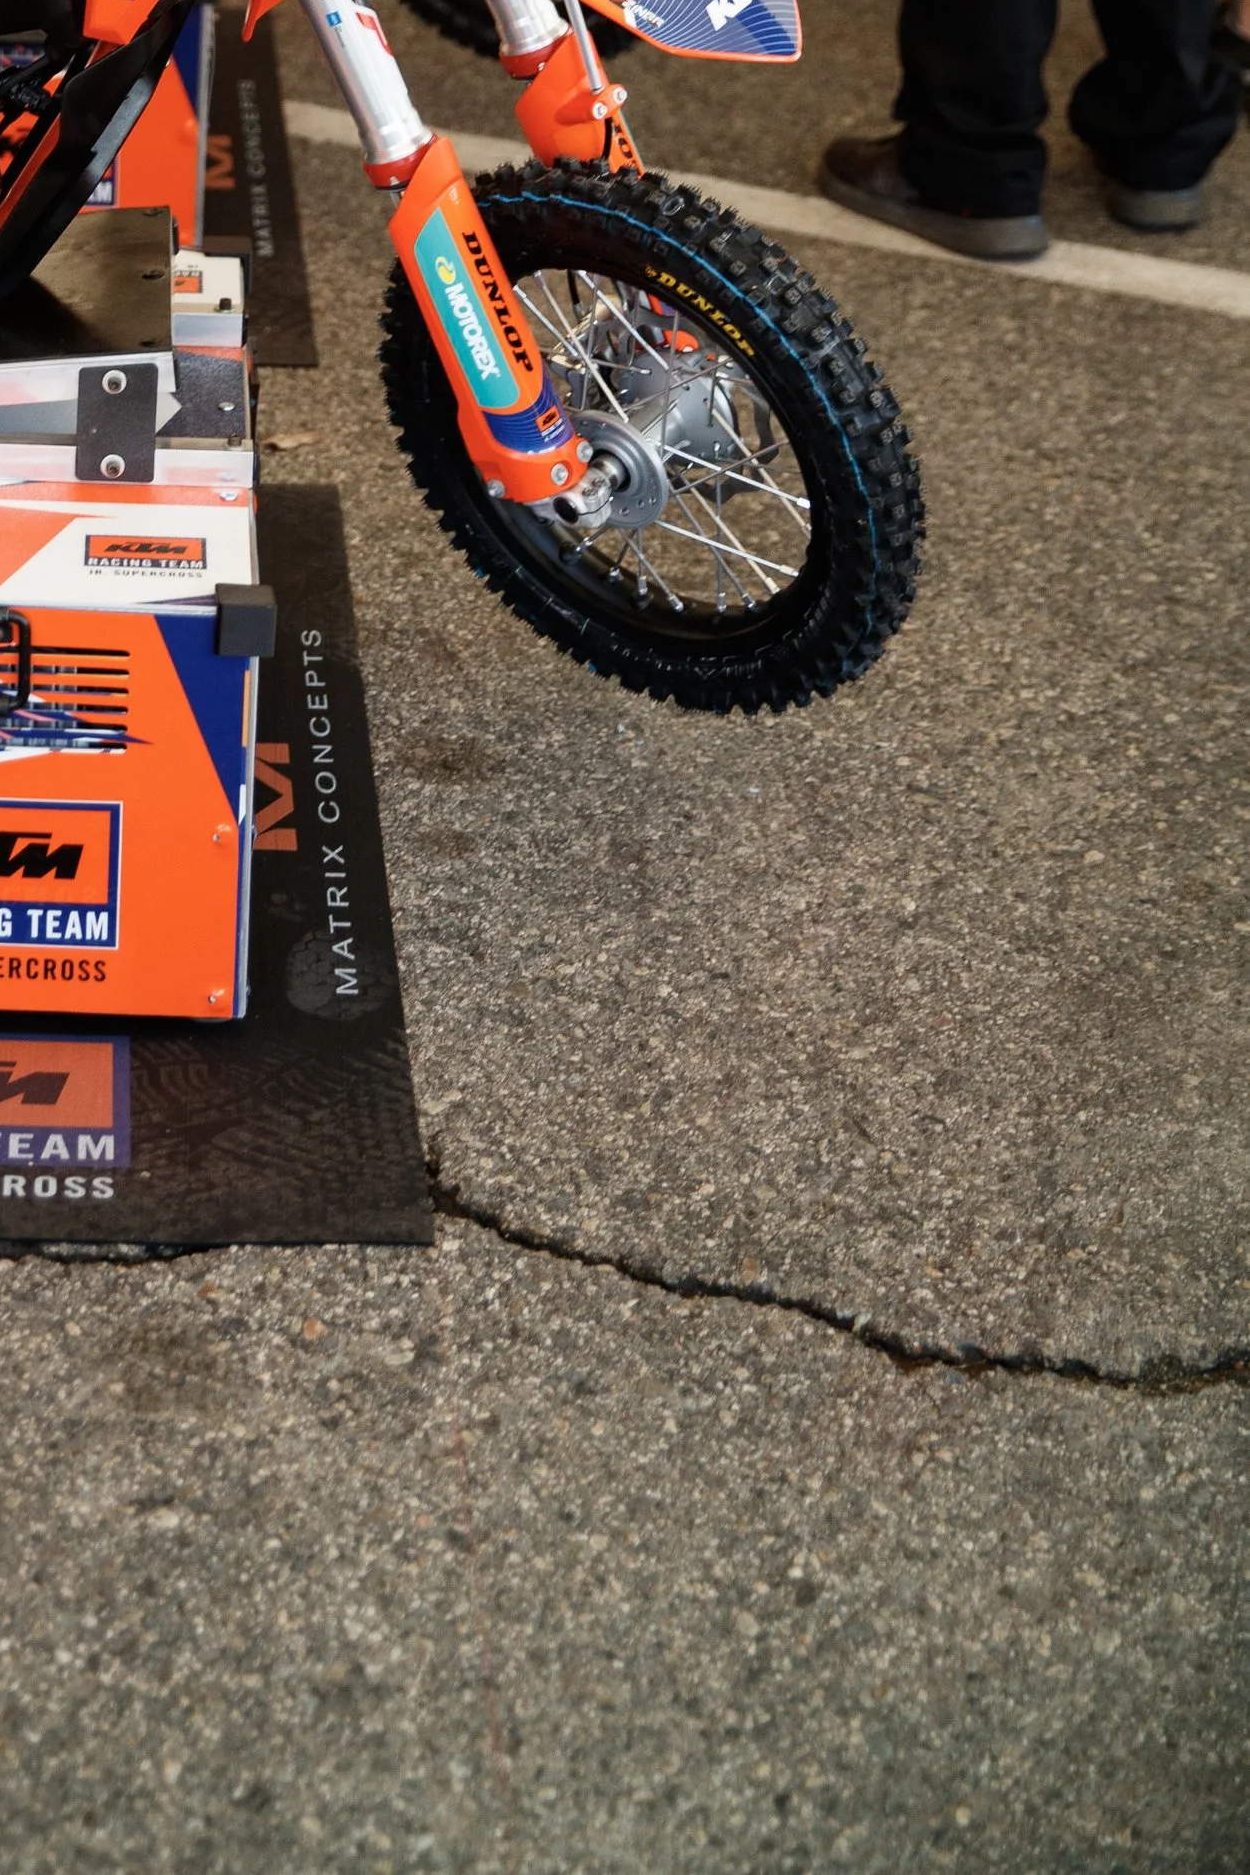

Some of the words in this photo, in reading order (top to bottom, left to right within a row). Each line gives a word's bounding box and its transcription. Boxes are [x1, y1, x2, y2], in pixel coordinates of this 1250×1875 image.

[445, 282, 500, 381] MOTOREX
[462, 231, 534, 373] DUNLOP
[658, 272, 755, 356] DUNLOP
[87, 557, 152, 569] RACING
[156, 559, 205, 570] TEAM
[104, 541, 189, 555] KTM
[113, 569, 204, 579] SUPERCROSS
[301, 628, 342, 824] CONCEPTS
[27, 908, 109, 941] TEAM
[322, 844, 360, 996] MATRIX
